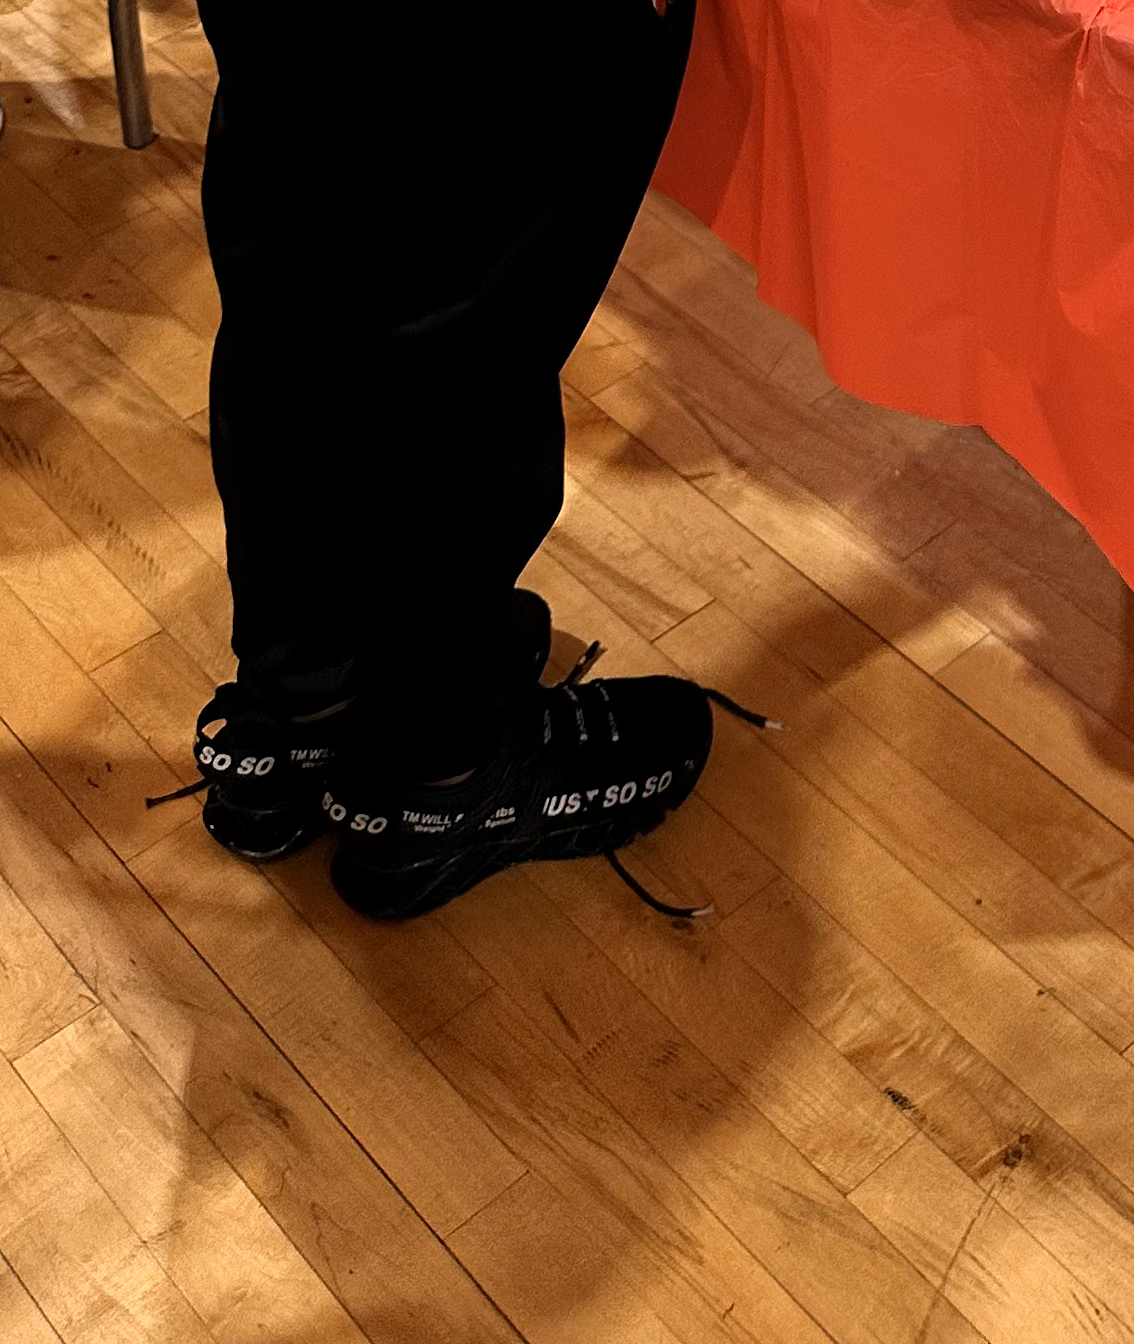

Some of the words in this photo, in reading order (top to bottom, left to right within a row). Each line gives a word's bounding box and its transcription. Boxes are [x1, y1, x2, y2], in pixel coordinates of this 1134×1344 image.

[199, 745, 232, 772] SO
[236, 756, 275, 777] SO
[602, 781, 638, 808] SO
[642, 769, 673, 798] SO
[350, 813, 388, 835] SO
